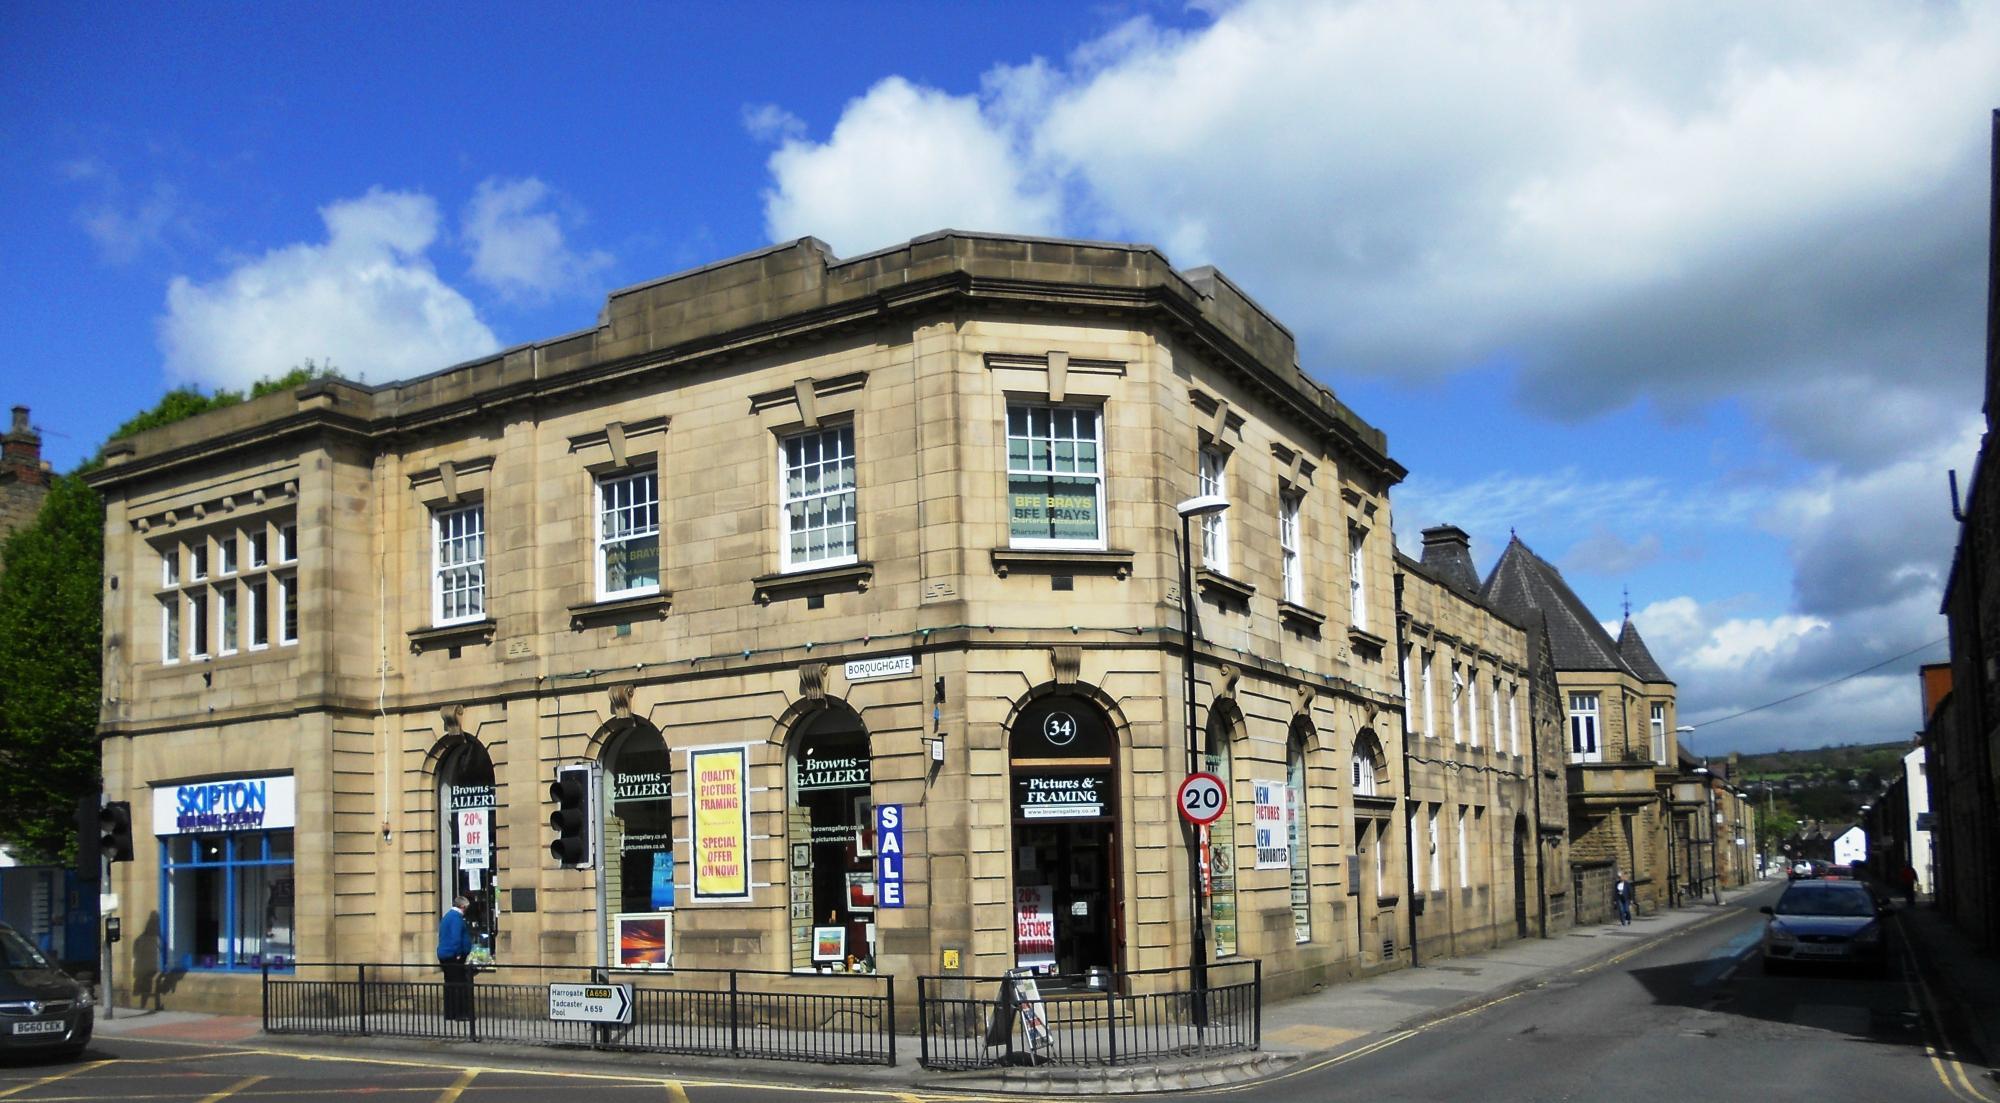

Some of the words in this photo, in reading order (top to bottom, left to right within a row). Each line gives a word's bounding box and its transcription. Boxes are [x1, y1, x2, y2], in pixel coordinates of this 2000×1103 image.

[1015, 496, 1040, 507] BFE
[1046, 497, 1092, 508] BRAYS
[849, 658, 910, 675] BOROUGHGATE
[1049, 720, 1071, 736] 34
[806, 758, 857, 770] Browns
[618, 773, 661, 784] Browns
[701, 769, 736, 783] QUALITY
[797, 769, 868, 786] GALLERY
[1030, 778, 1079, 789] Pictures
[1081, 777, 1095, 788] &
[453, 785, 489, 796] Browns
[701, 784, 737, 796] PICTURE
[1027, 790, 1097, 803] FRAMING
[176, 781, 266, 816] SKIPTON
[450, 795, 495, 808] ALLERY
[700, 798, 738, 810] FRAMING
[1186, 787, 1220, 809] 20
[1256, 805, 1280, 820] PICTURES
[464, 813, 482, 826] 20%
[467, 832, 481, 844] OFF
[702, 836, 737, 849] SPECIAL
[707, 851, 732, 863] OFFER
[881, 806, 900, 904] SALE
[702, 866, 713, 877] ON
[715, 865, 739, 877] NOW!
[1022, 905, 1038, 919] OFF
[1019, 921, 1051, 937] CTURE
[552, 989, 584, 997] Harrogate
[552, 1000, 583, 1008] Tadcaster
[552, 1008, 566, 1017] Pool
